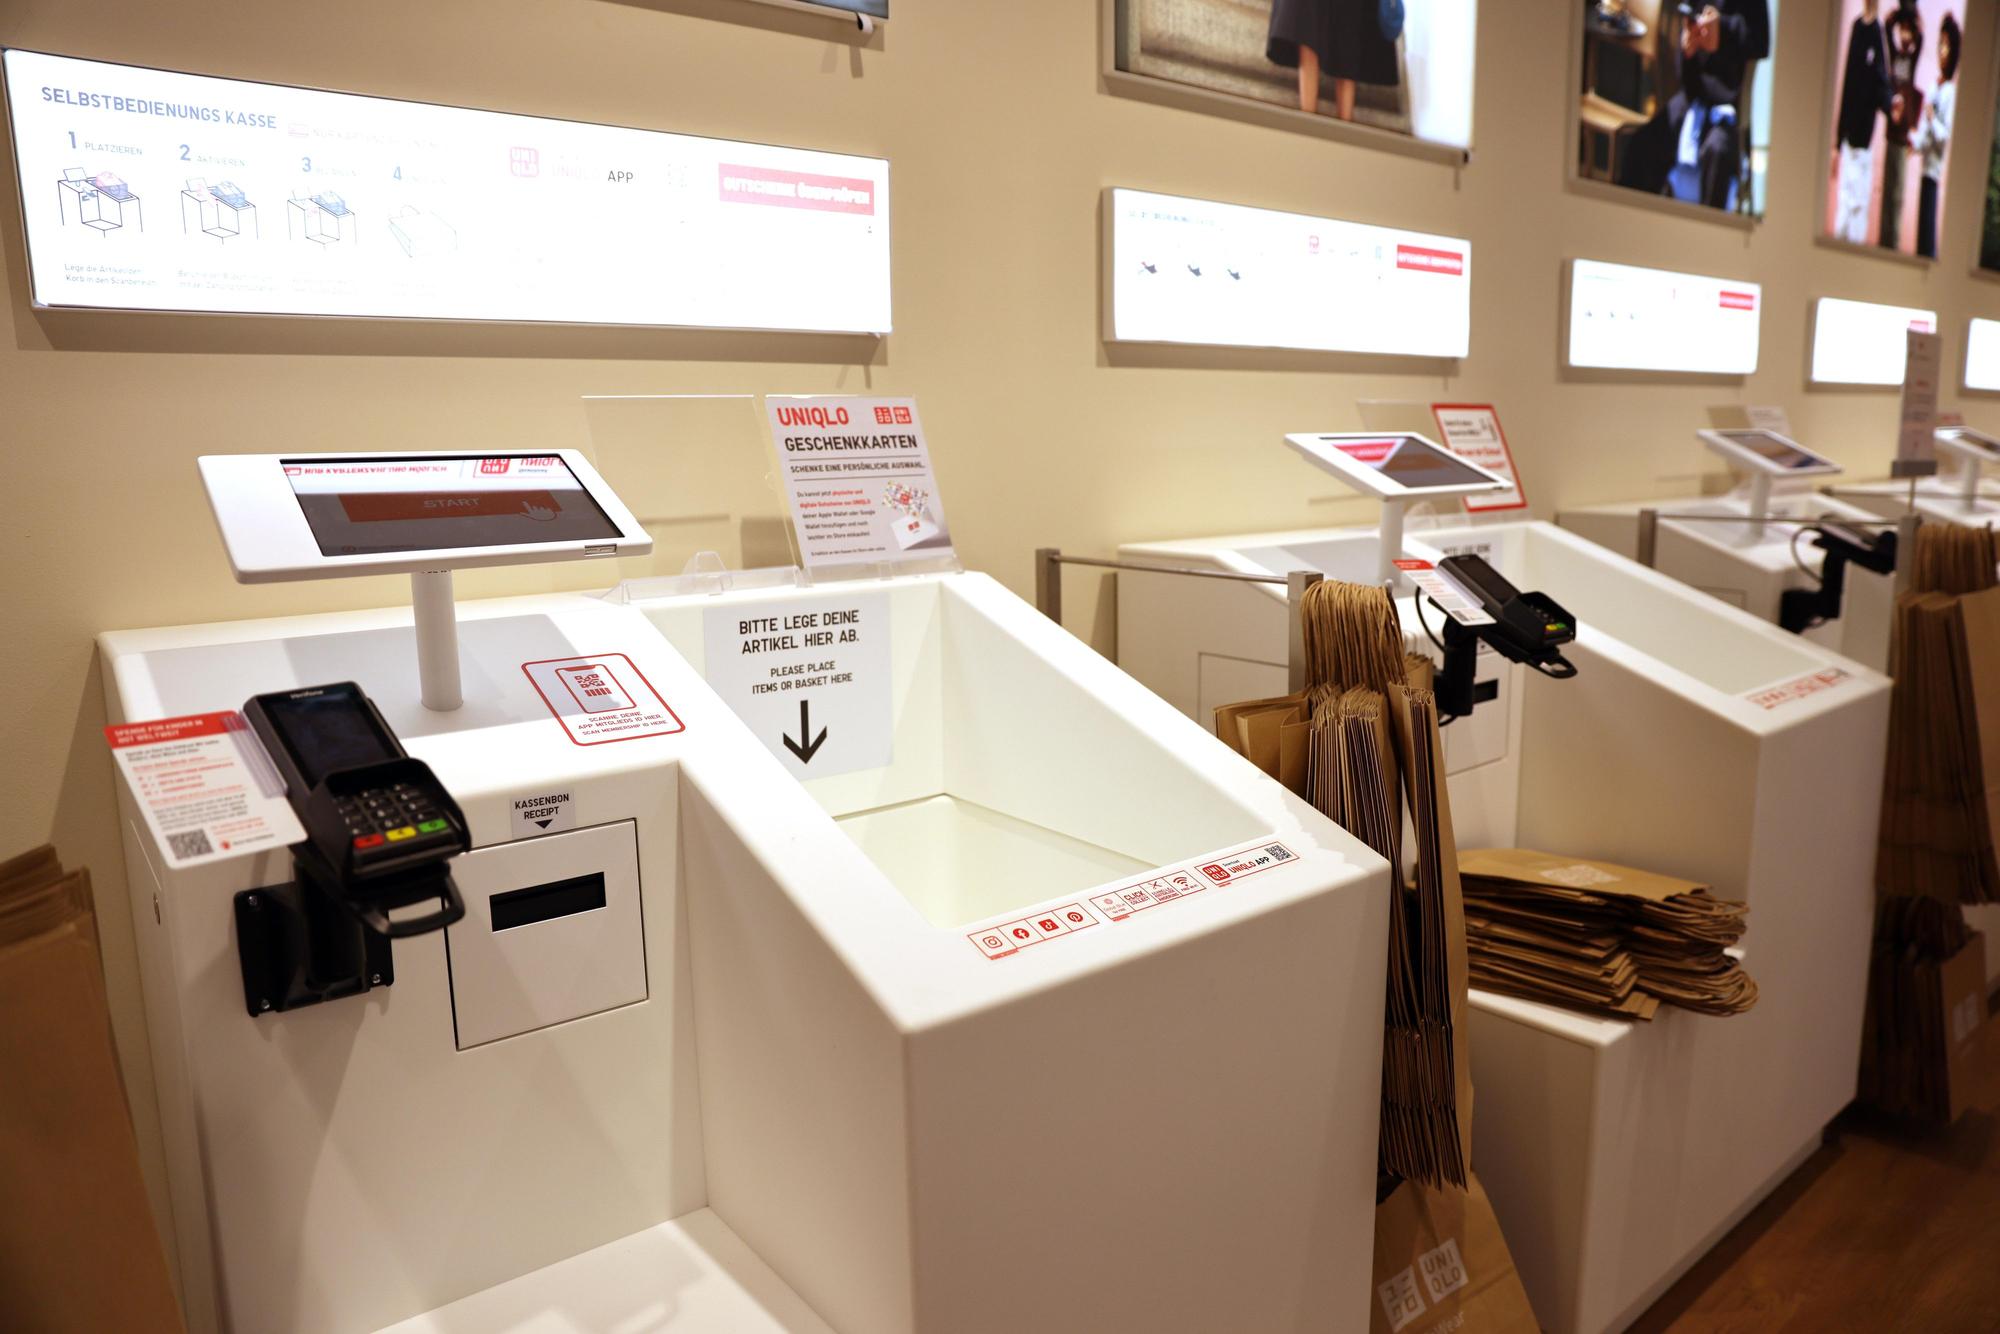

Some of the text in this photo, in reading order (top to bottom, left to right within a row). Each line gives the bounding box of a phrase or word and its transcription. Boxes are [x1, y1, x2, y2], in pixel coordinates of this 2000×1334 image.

[41, 87, 277, 129] SELBSTBEDIENUNGS KASSE
[68, 131, 143, 155] 1 PLATZIEREN
[179, 144, 191, 161] 2
[302, 157, 311, 172] 3
[393, 166, 402, 180] 4
[607, 170, 634, 184] APP
[777, 407, 849, 428] UNIQLO
[785, 435, 917, 451] GESCHENKKARTEN
[790, 461, 926, 473] SCHENKE EINE PERSÖNLICHE AUSWAHL.
[424, 497, 480, 509] START
[739, 610, 860, 635] BITTE LEGE DEINE
[742, 629, 860, 654] ARTIKEL HIER AB.
[770, 661, 836, 678] PLEASE PLACE
[752, 672, 853, 695] ITEMS OR BASKET HERE
[588, 714, 619, 722] SCANNE
[596, 718, 633, 727] MITGLIEDS
[602, 724, 640, 733] MEMBERSHIP
[515, 793, 569, 810] KASSENBON
[524, 806, 560, 820] RECEIPT
[1204, 865, 1220, 874] UNI
[1228, 856, 1270, 873] UNIQLO APP
[1211, 871, 1228, 880] QLO
[1123, 890, 1144, 901] CLICK
[1424, 1249, 1454, 1274] UNI
[1431, 1267, 1461, 1293] QLO
